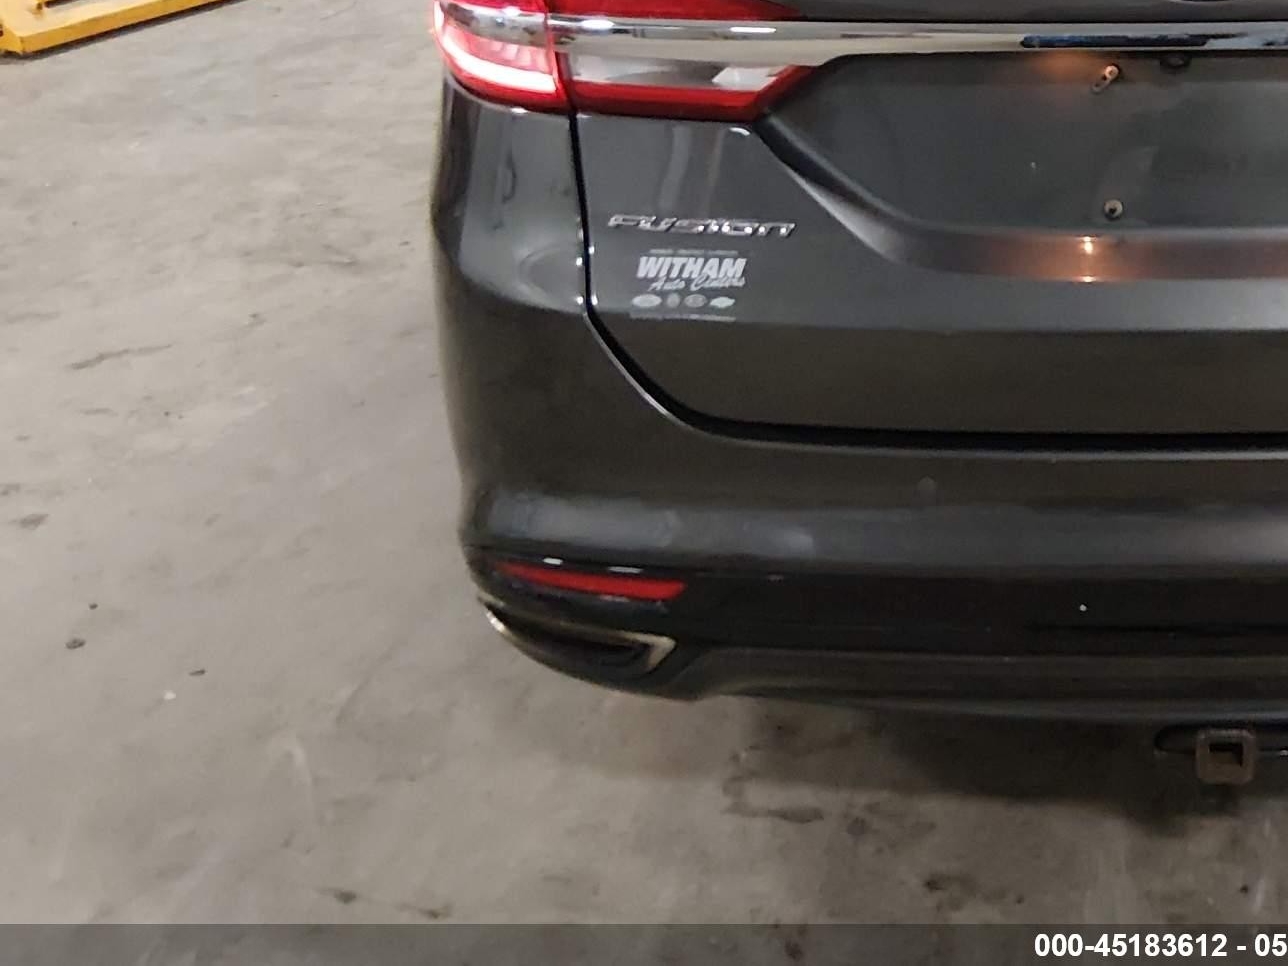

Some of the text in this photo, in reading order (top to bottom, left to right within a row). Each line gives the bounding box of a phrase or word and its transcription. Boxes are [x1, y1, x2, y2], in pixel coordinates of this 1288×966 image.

[607, 214, 797, 238] FUSION
[637, 256, 747, 279] WITHAM
[648, 276, 686, 292] Auto
